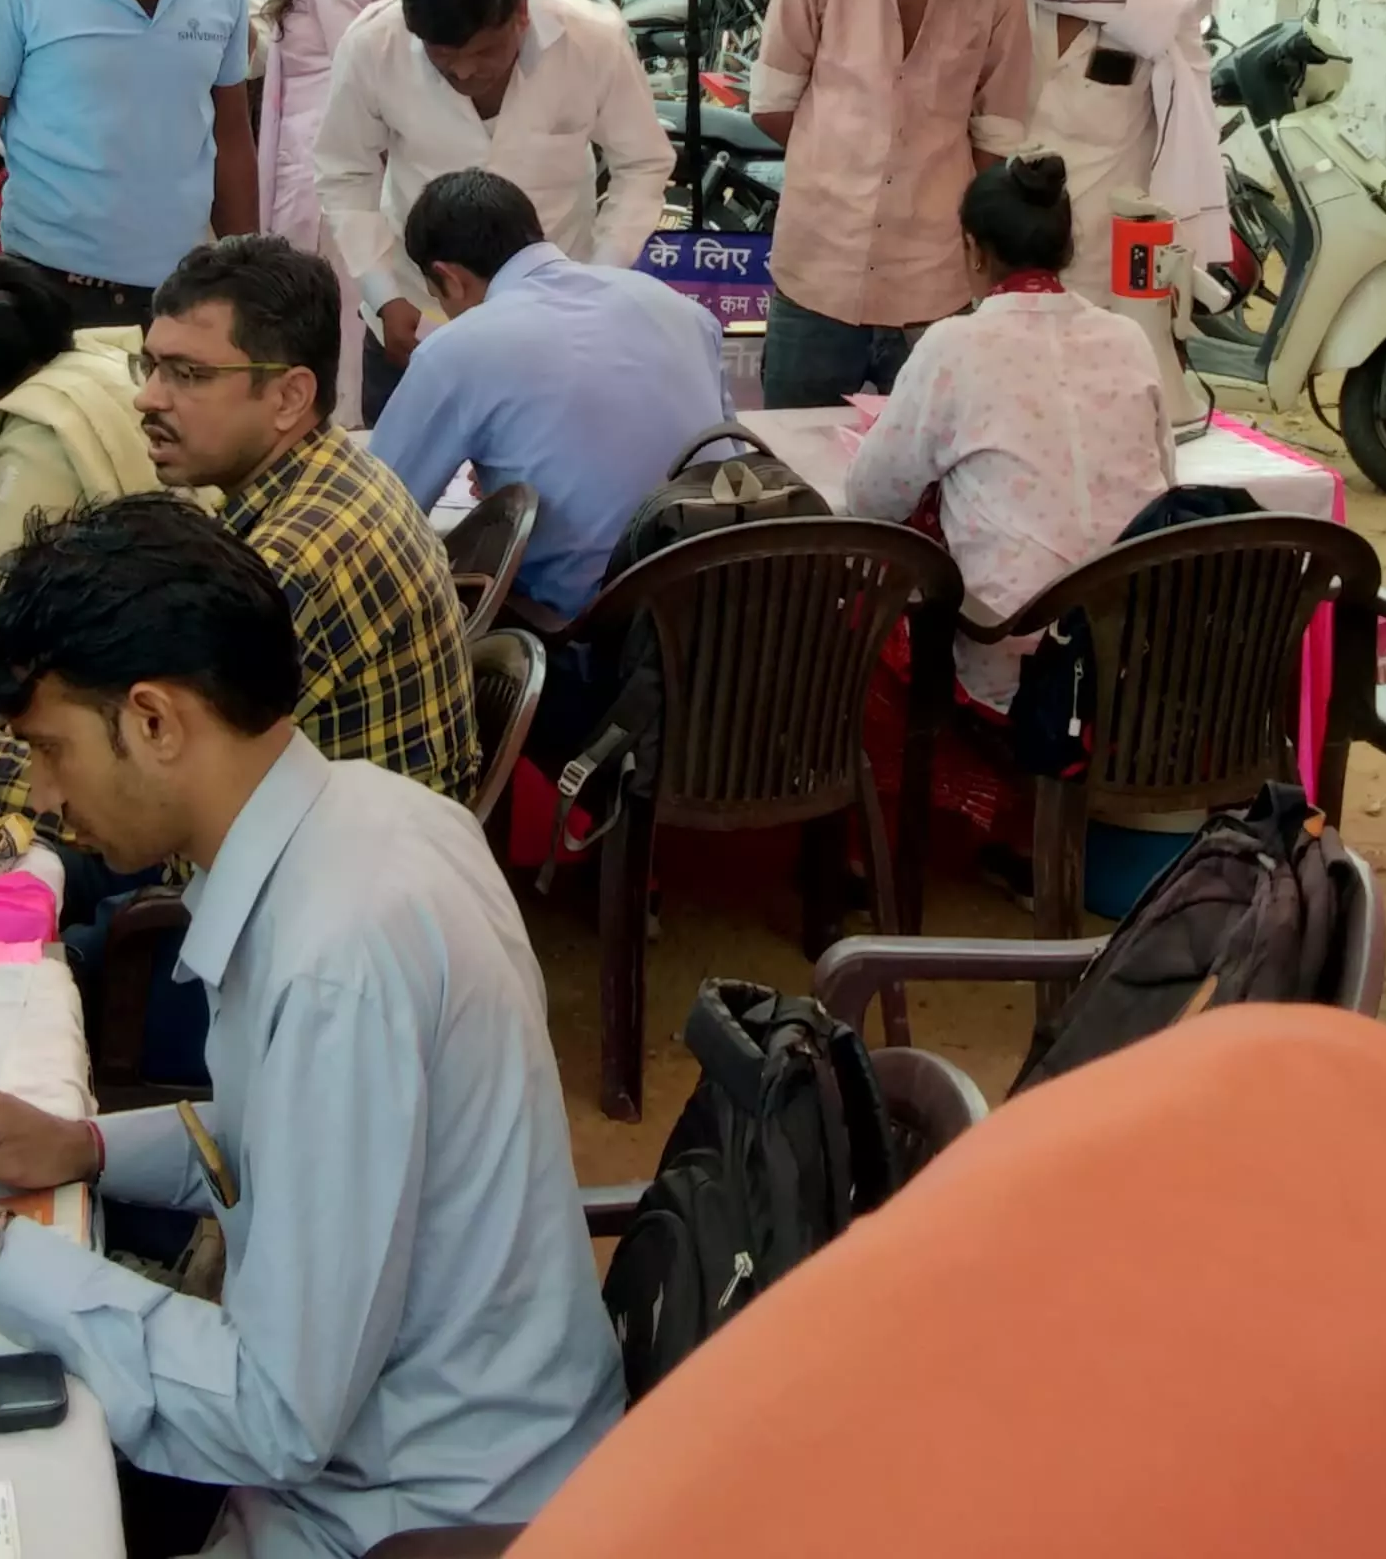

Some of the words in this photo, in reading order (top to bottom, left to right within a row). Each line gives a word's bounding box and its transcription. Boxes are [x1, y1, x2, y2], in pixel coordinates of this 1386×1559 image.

[648, 236, 681, 268] के
[693, 238, 751, 276] लिए
[720, 295, 750, 315] कम
